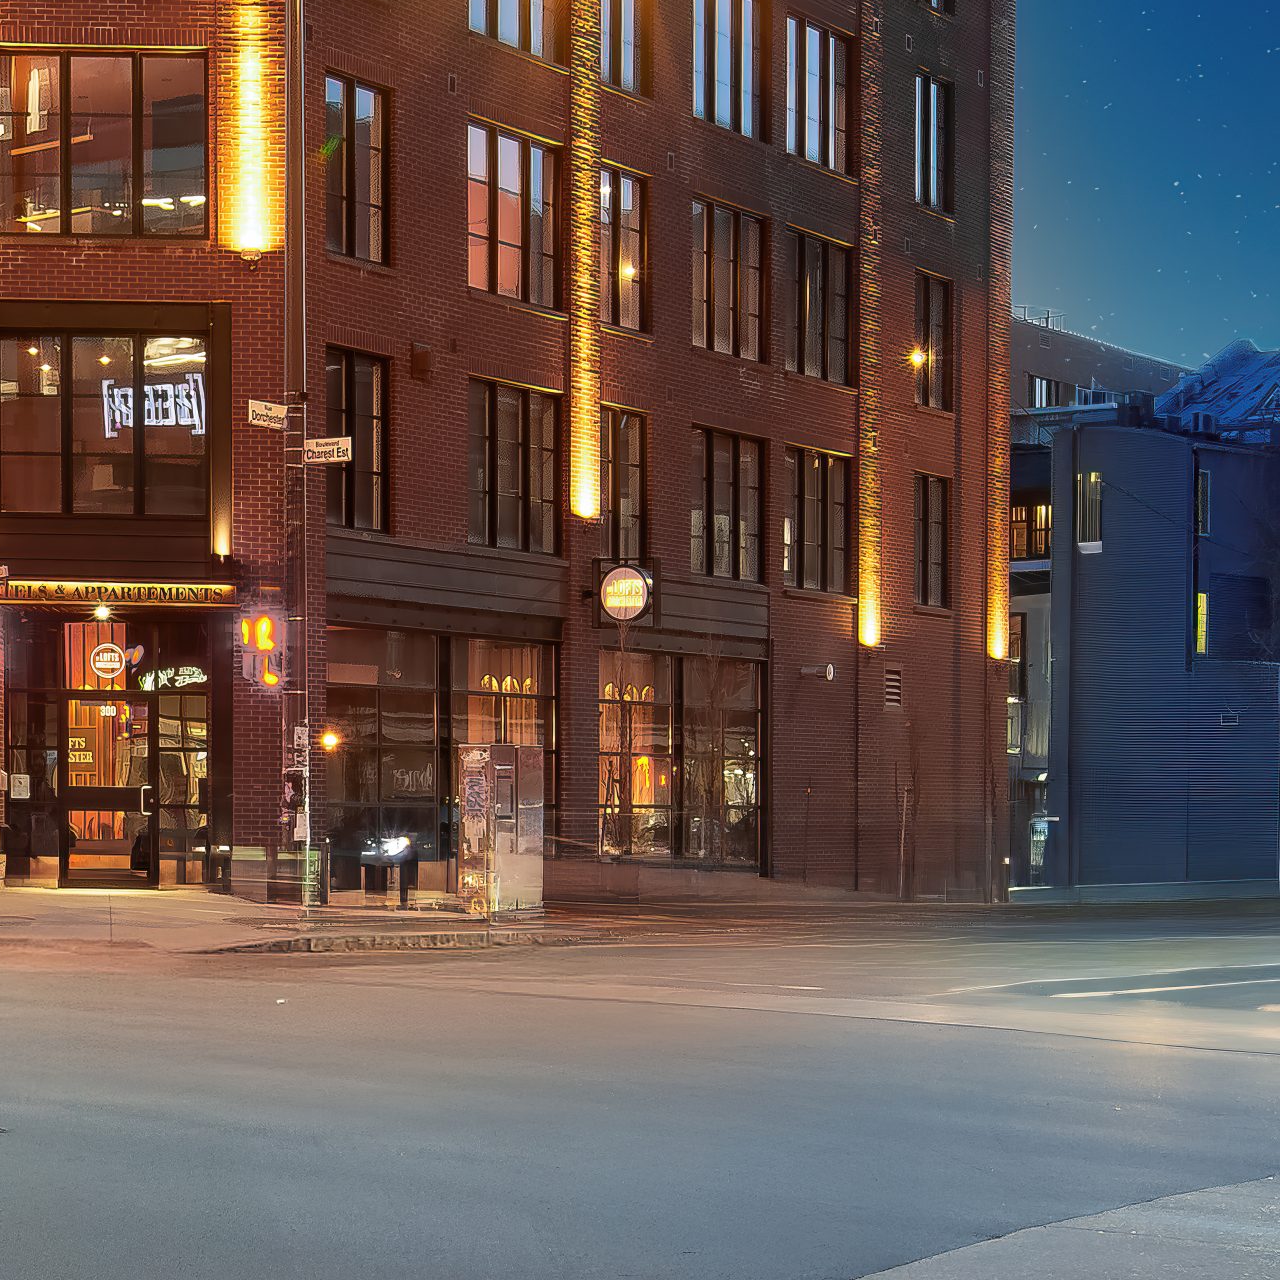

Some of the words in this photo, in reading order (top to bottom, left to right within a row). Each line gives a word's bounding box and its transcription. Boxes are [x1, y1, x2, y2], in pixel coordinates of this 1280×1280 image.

[306, 447, 335, 460] Charest
[337, 446, 349, 459] Est
[54, 583, 66, 598] &
[71, 585, 224, 603] APPARTEMENTS
[100, 652, 120, 662] LOFTS
[100, 705, 117, 717] 300
